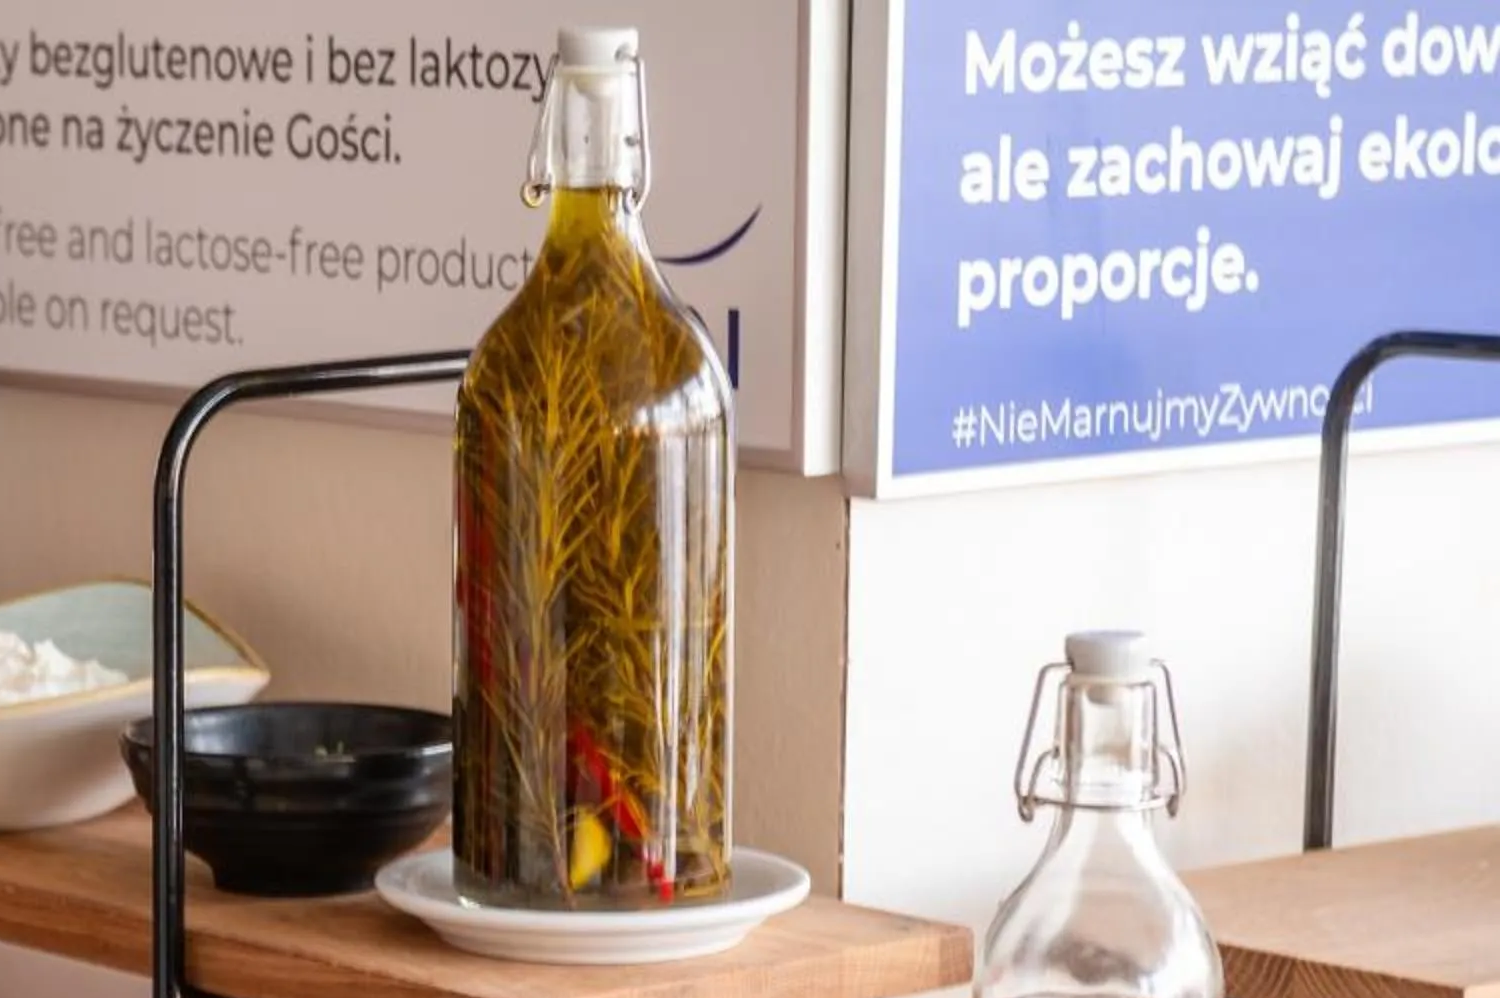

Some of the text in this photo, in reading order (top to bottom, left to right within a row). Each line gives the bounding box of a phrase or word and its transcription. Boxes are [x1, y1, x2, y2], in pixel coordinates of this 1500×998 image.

[29, 28, 294, 90] bezglutenowe
[305, 33, 313, 84] i
[327, 34, 397, 87] bez
[409, 35, 557, 103] laktozy
[964, 19, 1186, 96] Możesz
[1201, 11, 1368, 99] wziąć
[61, 113, 105, 151] na
[116, 103, 275, 164] życzenie
[285, 112, 402, 164] Gości.
[959, 133, 1050, 204] ale
[1066, 113, 1343, 200] zachowaj
[66, 216, 135, 265] and
[145, 217, 366, 281] lactose-free
[376, 235, 534, 294] product
[957, 224, 1259, 328] proporcje.
[44, 293, 90, 331] on
[99, 297, 244, 347] request.
